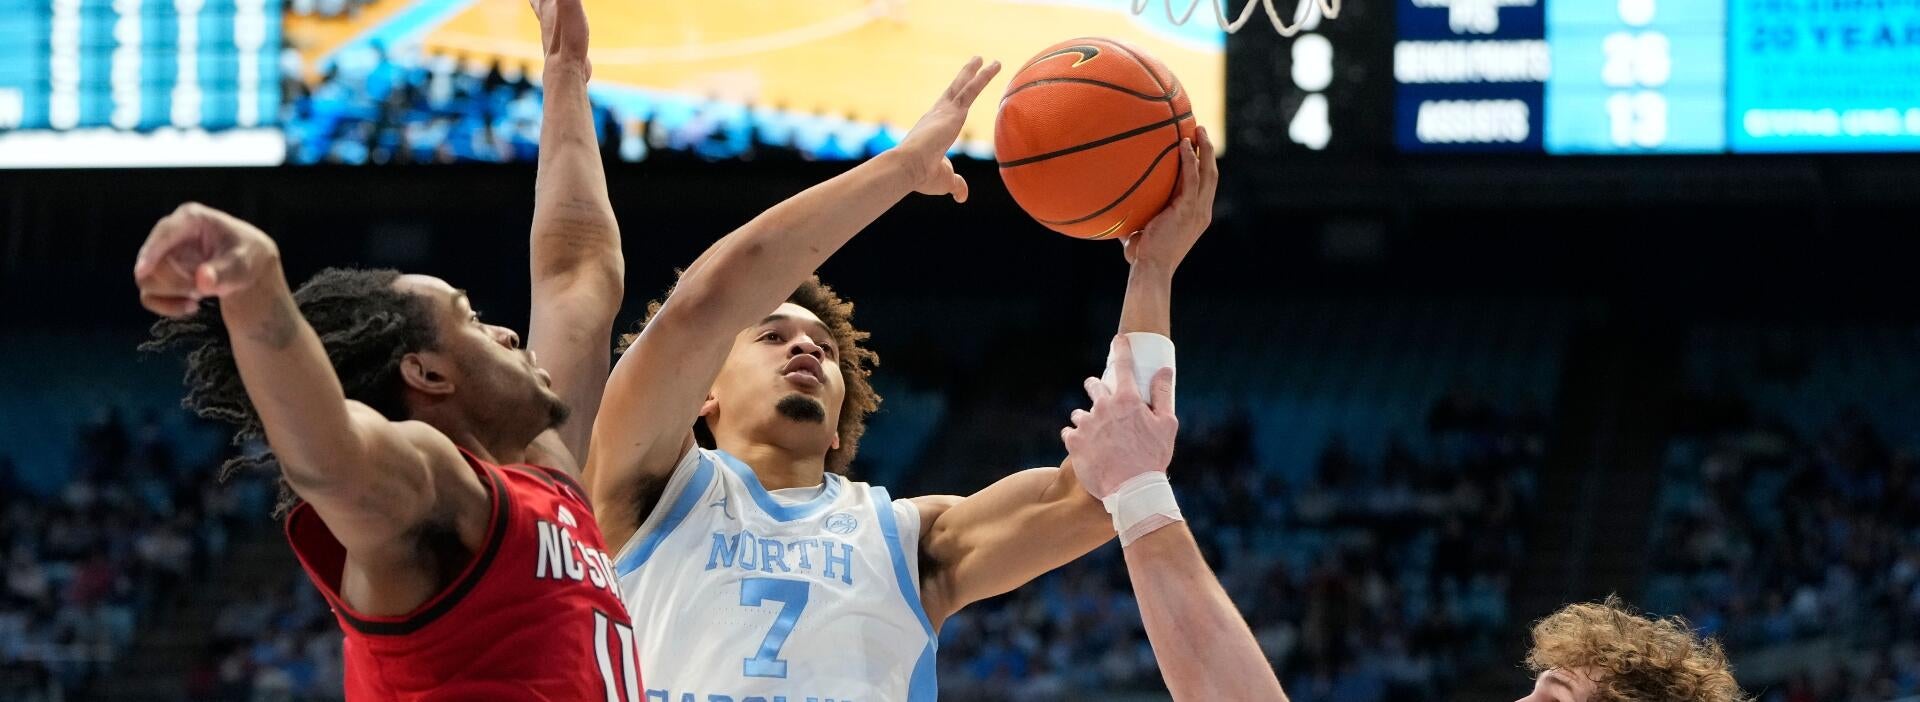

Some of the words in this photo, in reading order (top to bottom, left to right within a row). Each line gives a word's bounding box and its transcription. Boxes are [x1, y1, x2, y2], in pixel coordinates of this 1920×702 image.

[1289, 92, 1332, 150] 4
[535, 519, 585, 581] NC
[705, 529, 854, 585] NORTH
[593, 608, 642, 702] 11
[740, 577, 810, 678] 7
